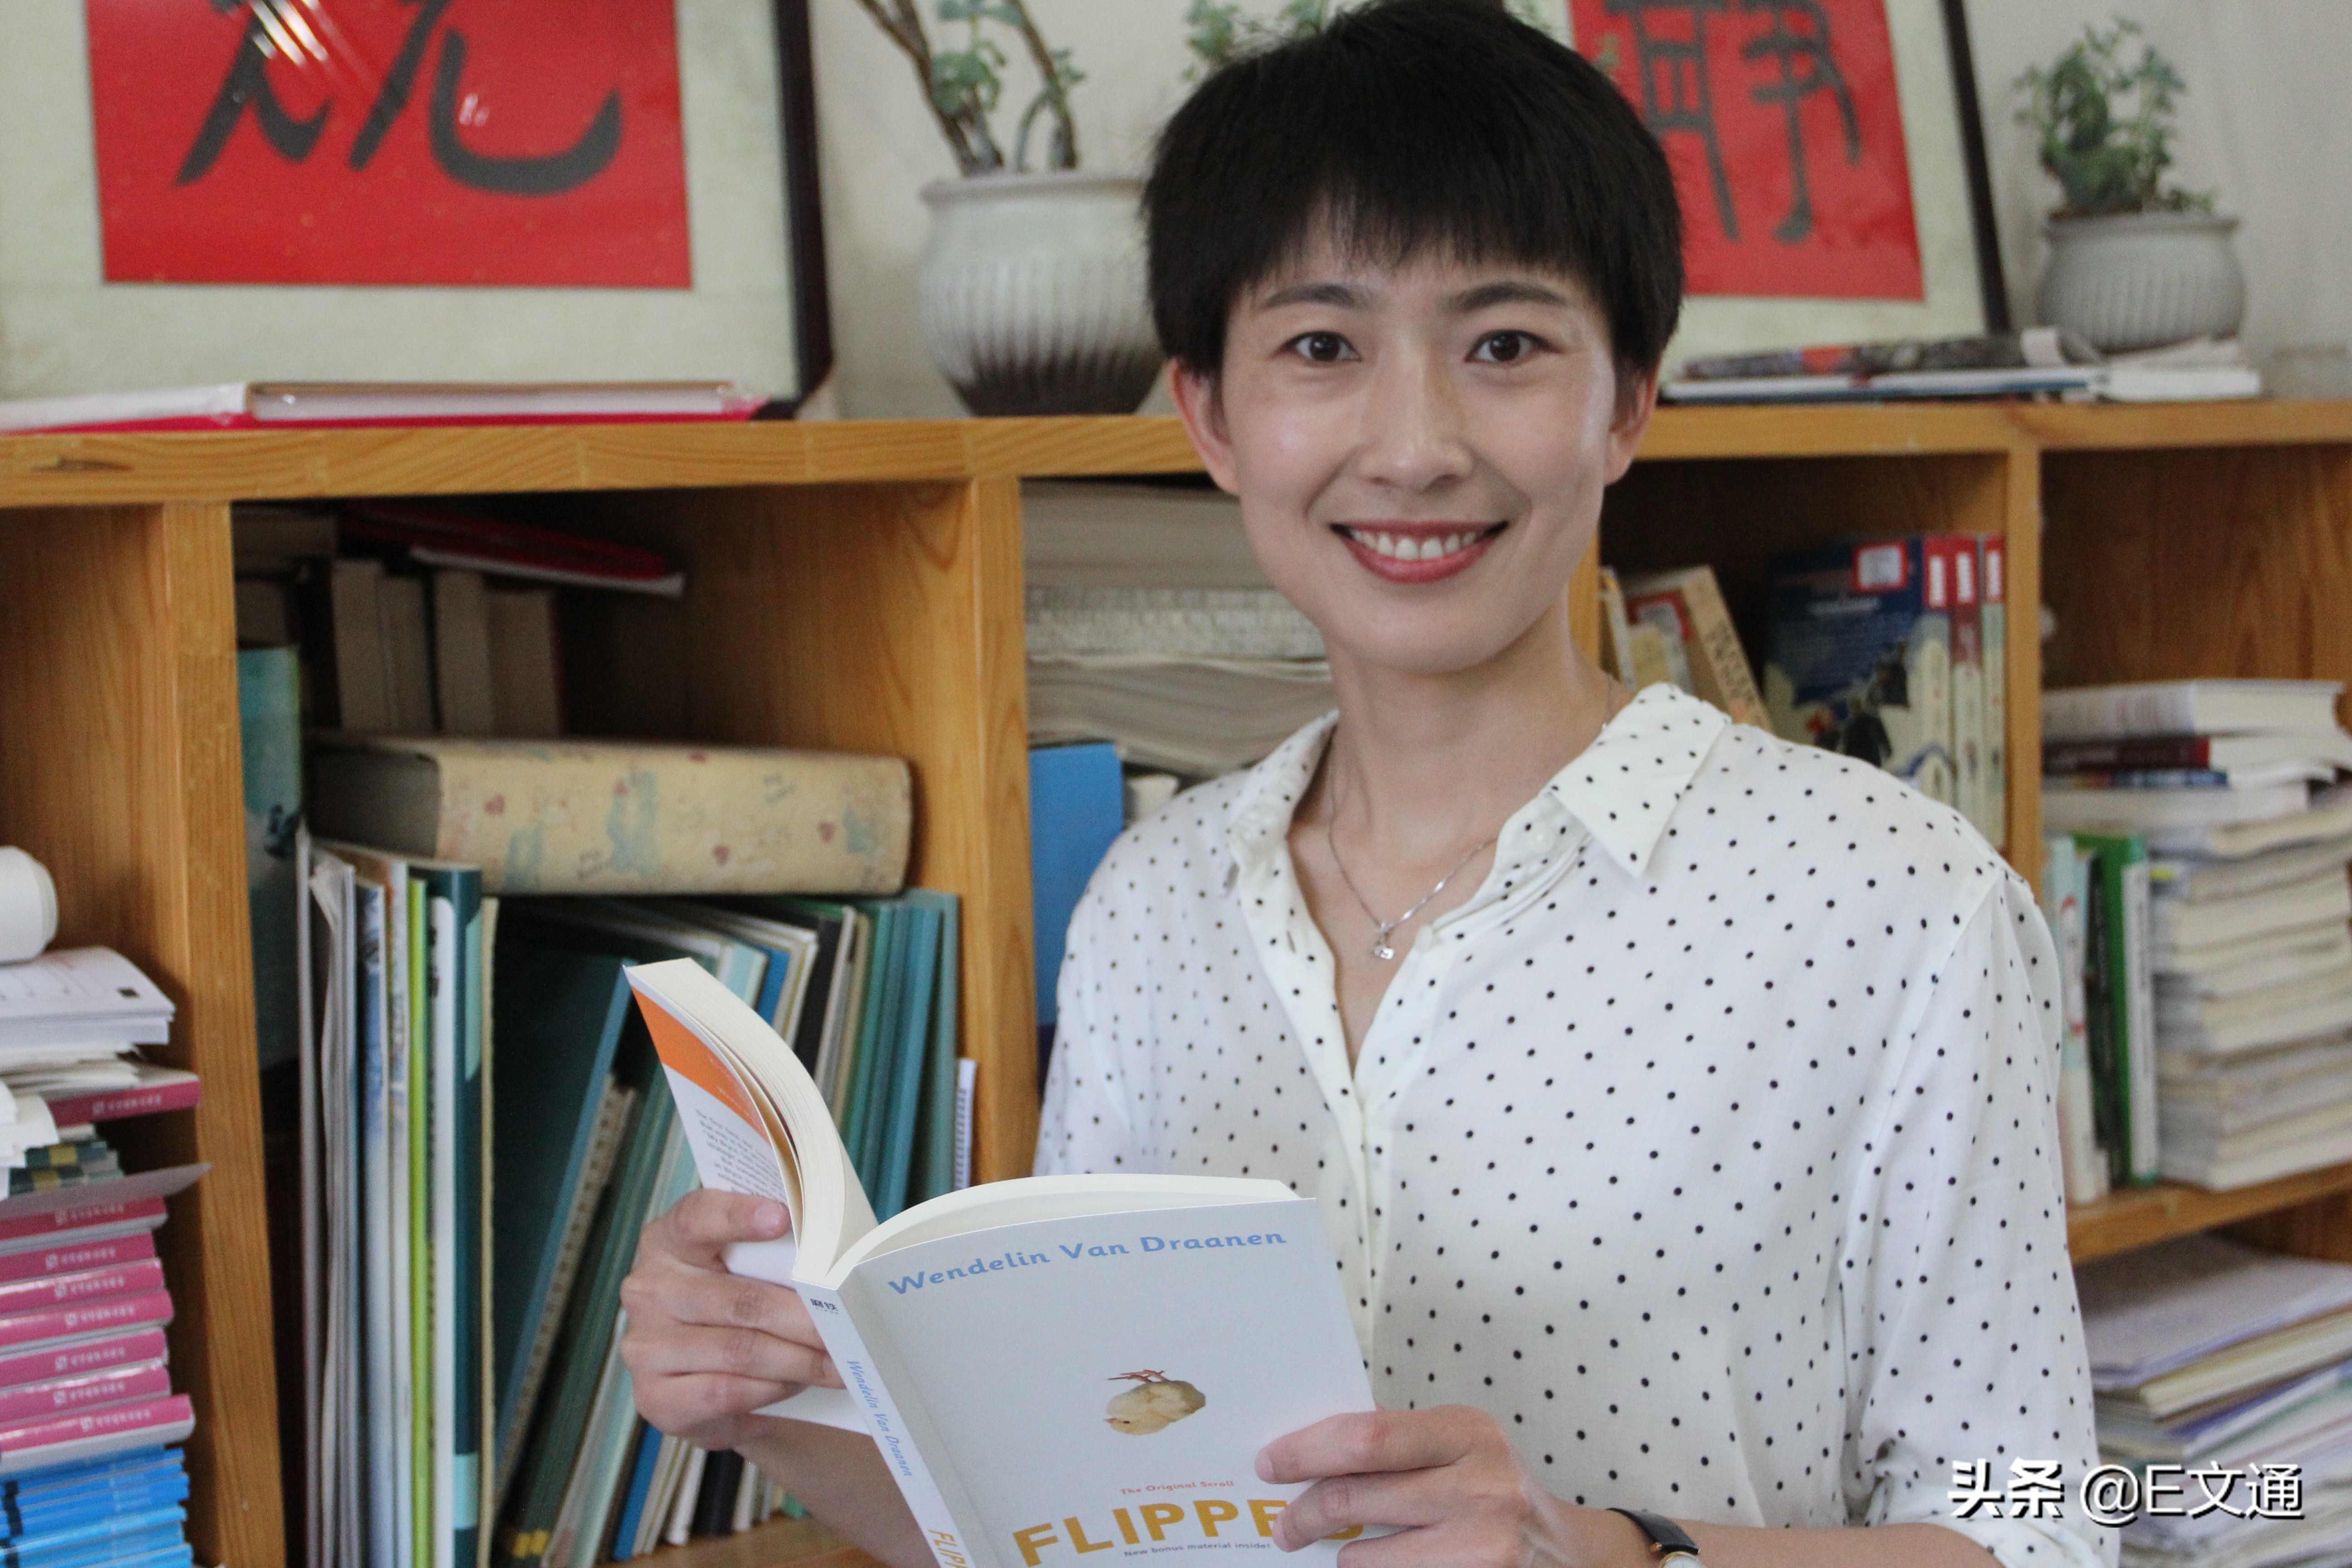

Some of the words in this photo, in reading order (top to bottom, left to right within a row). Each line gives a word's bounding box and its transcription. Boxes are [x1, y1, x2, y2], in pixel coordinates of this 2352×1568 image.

[888, 1250, 1051, 1295] Wendelin
[1058, 1242, 1130, 1260] Van
[1139, 1230, 1287, 1253] Draanen
[847, 1361, 878, 1408] Wendelin
[875, 1413, 889, 1432] Van
[885, 1436, 912, 1476] Draanen
[1146, 1483, 1196, 1492] Original
[1013, 1499, 1363, 1568] FLIPPE
